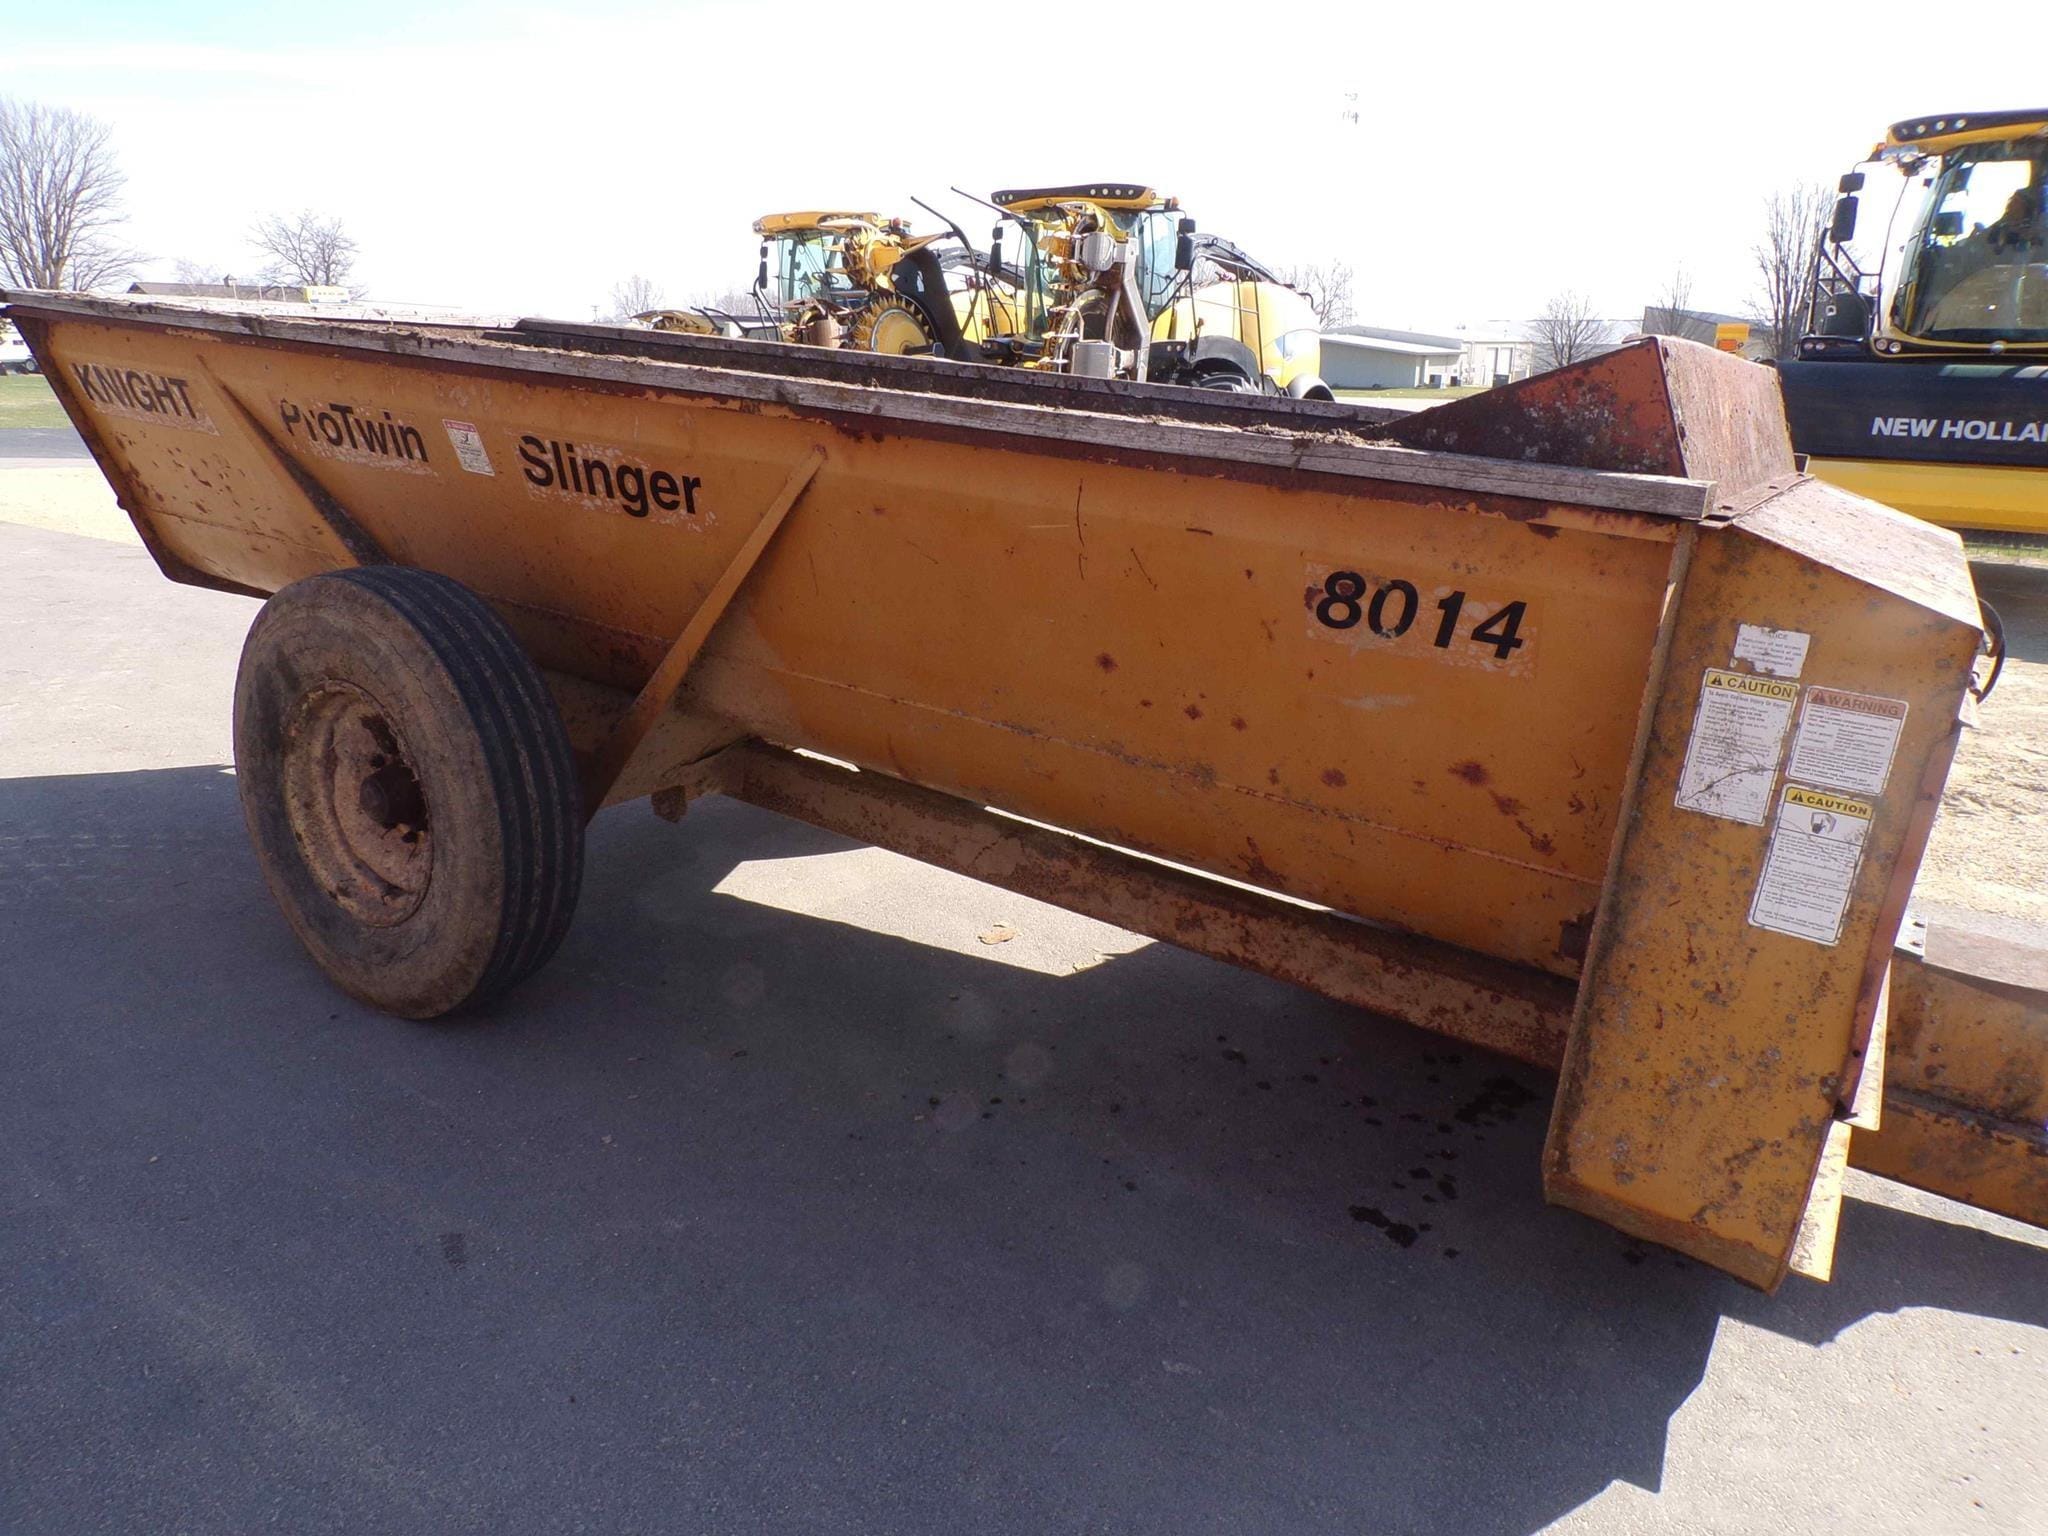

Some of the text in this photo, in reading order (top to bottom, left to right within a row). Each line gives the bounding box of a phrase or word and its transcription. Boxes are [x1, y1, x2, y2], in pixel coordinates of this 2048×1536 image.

[70, 362, 198, 420] KNIGHT
[1871, 416, 2048, 443] NEW HOLLA
[281, 399, 429, 463] ProTwin
[519, 435, 702, 518] Slinger
[1315, 570, 1528, 660] 8014
[1727, 678, 1792, 698] CAUTION
[1828, 694, 1899, 716] WARNING
[1806, 795, 1868, 815] CAUTION
